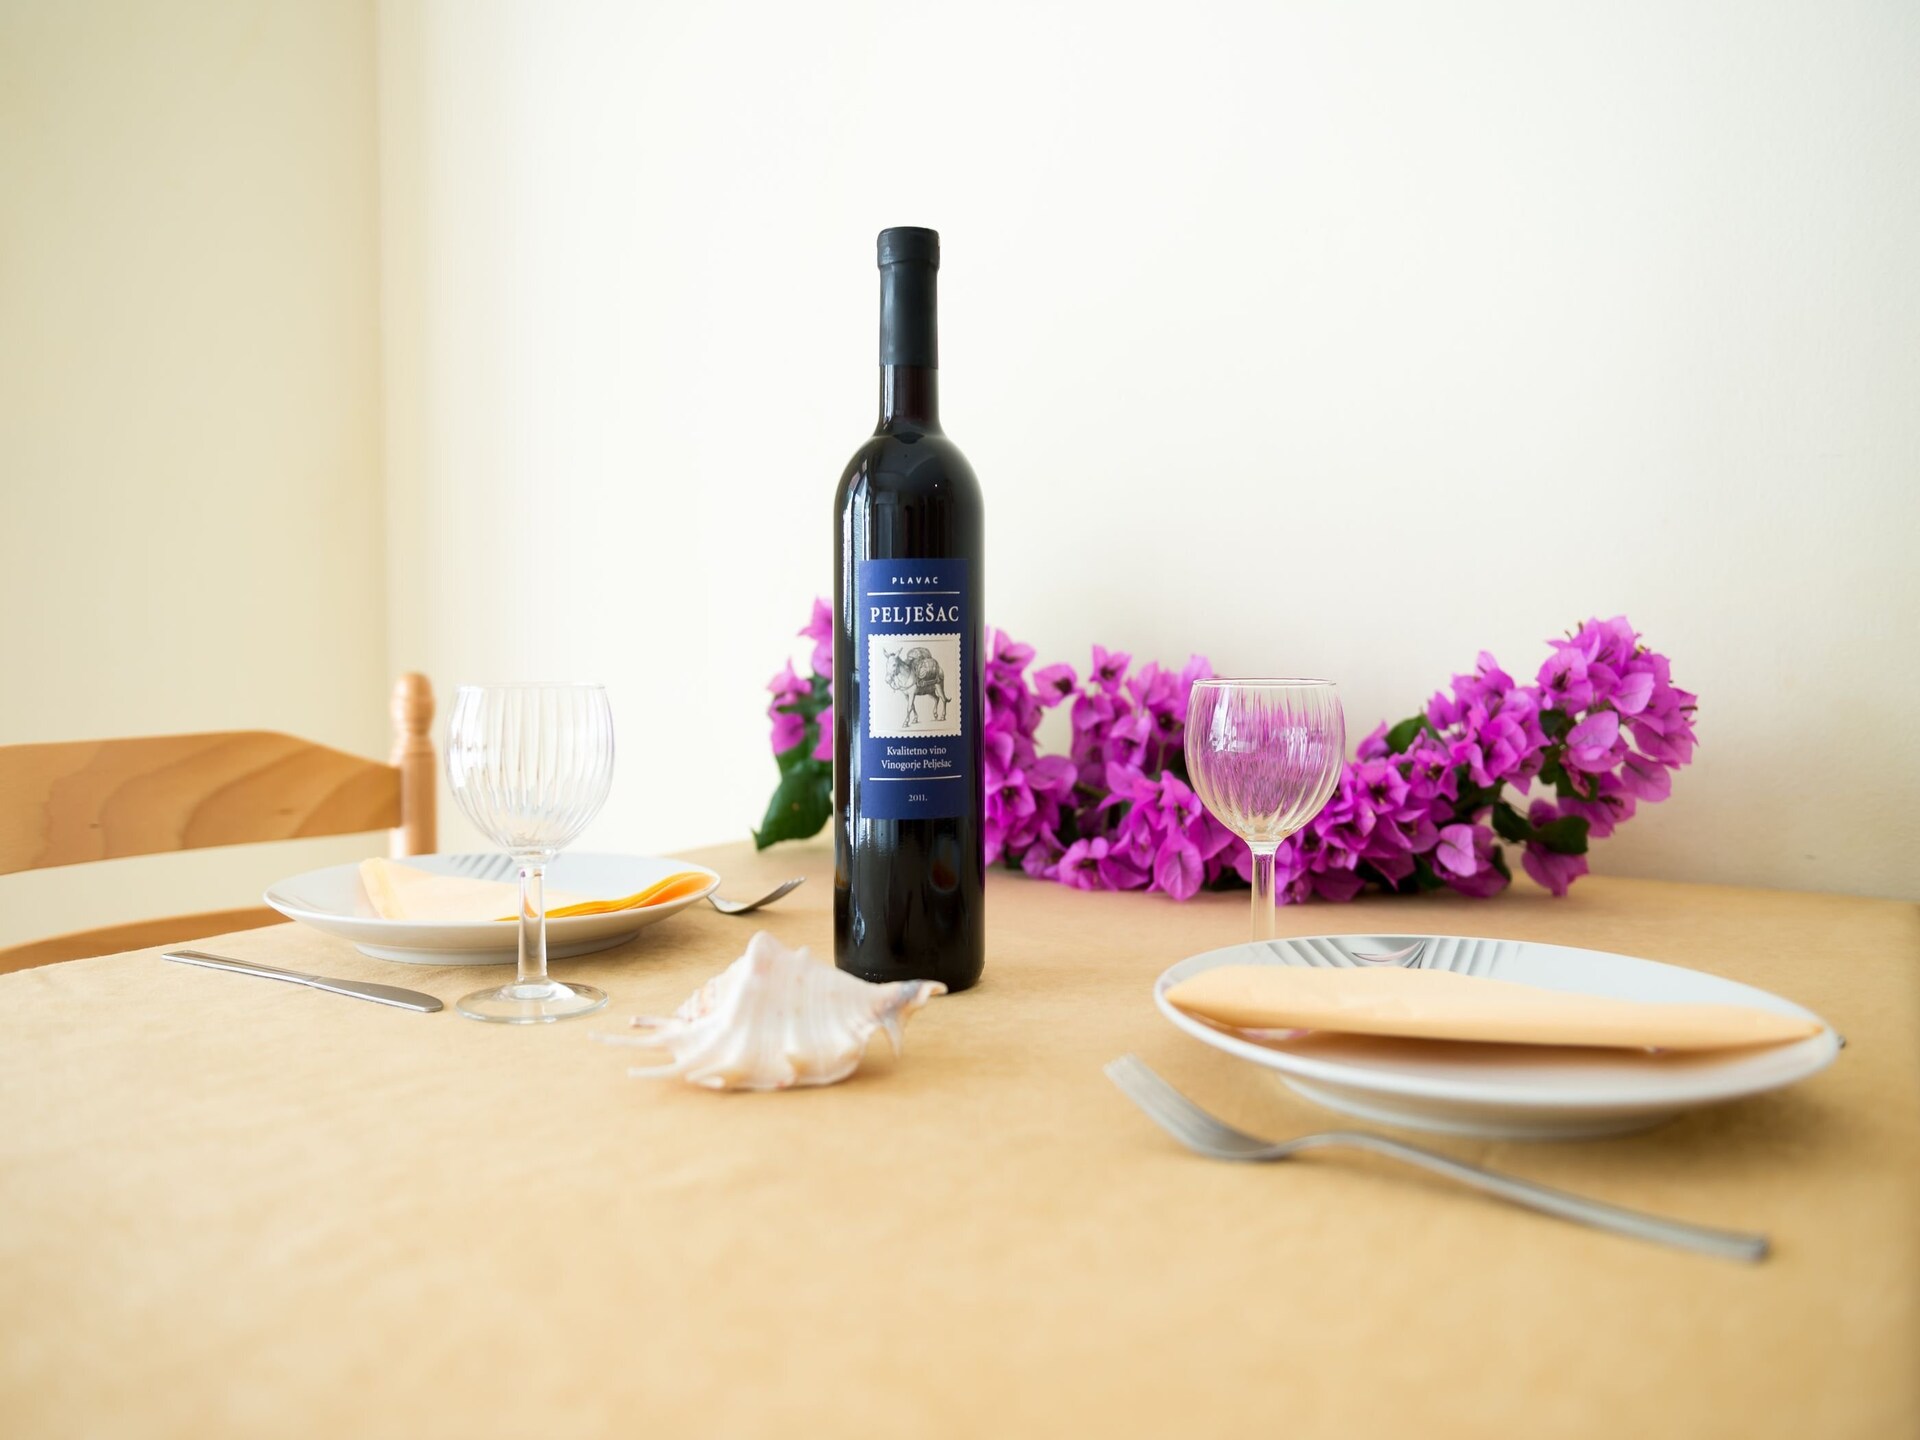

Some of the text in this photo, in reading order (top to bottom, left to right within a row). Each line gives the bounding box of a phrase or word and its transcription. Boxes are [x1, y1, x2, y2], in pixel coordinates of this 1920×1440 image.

[892, 576, 938, 585] PLAVAC
[870, 603, 960, 625] PELJEŠAC
[886, 745, 947, 756] Kvalitetno vino
[881, 759, 952, 771] Vinogorje Pelješac
[908, 794, 928, 802] 2011.
